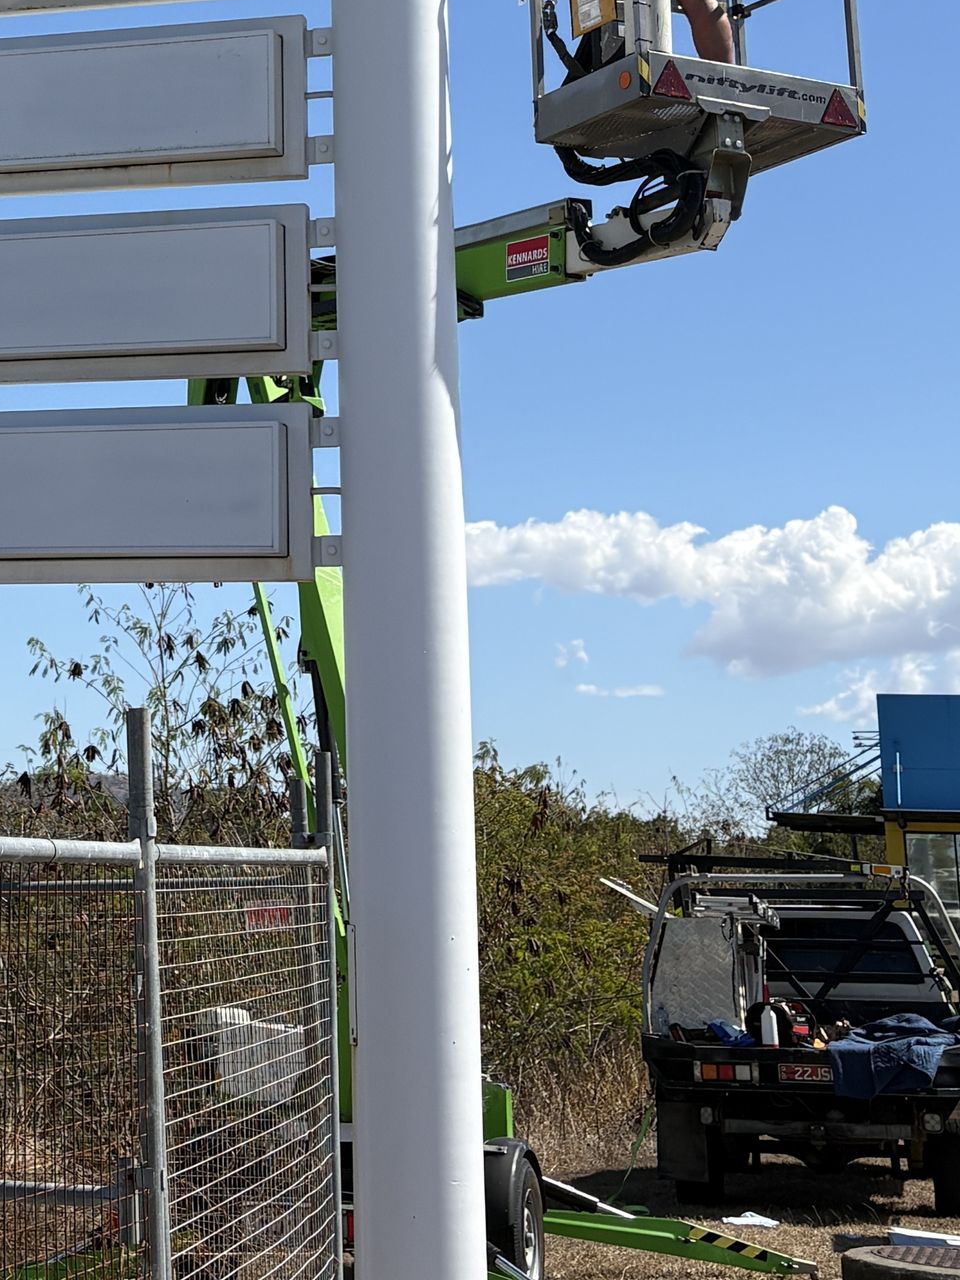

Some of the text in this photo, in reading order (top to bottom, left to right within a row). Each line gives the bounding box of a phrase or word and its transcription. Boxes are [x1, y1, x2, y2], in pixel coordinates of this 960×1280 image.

[684, 73, 826, 104] niftylift.com
[508, 247, 548, 266] KENNARDS
[531, 263, 547, 275] HIRE
